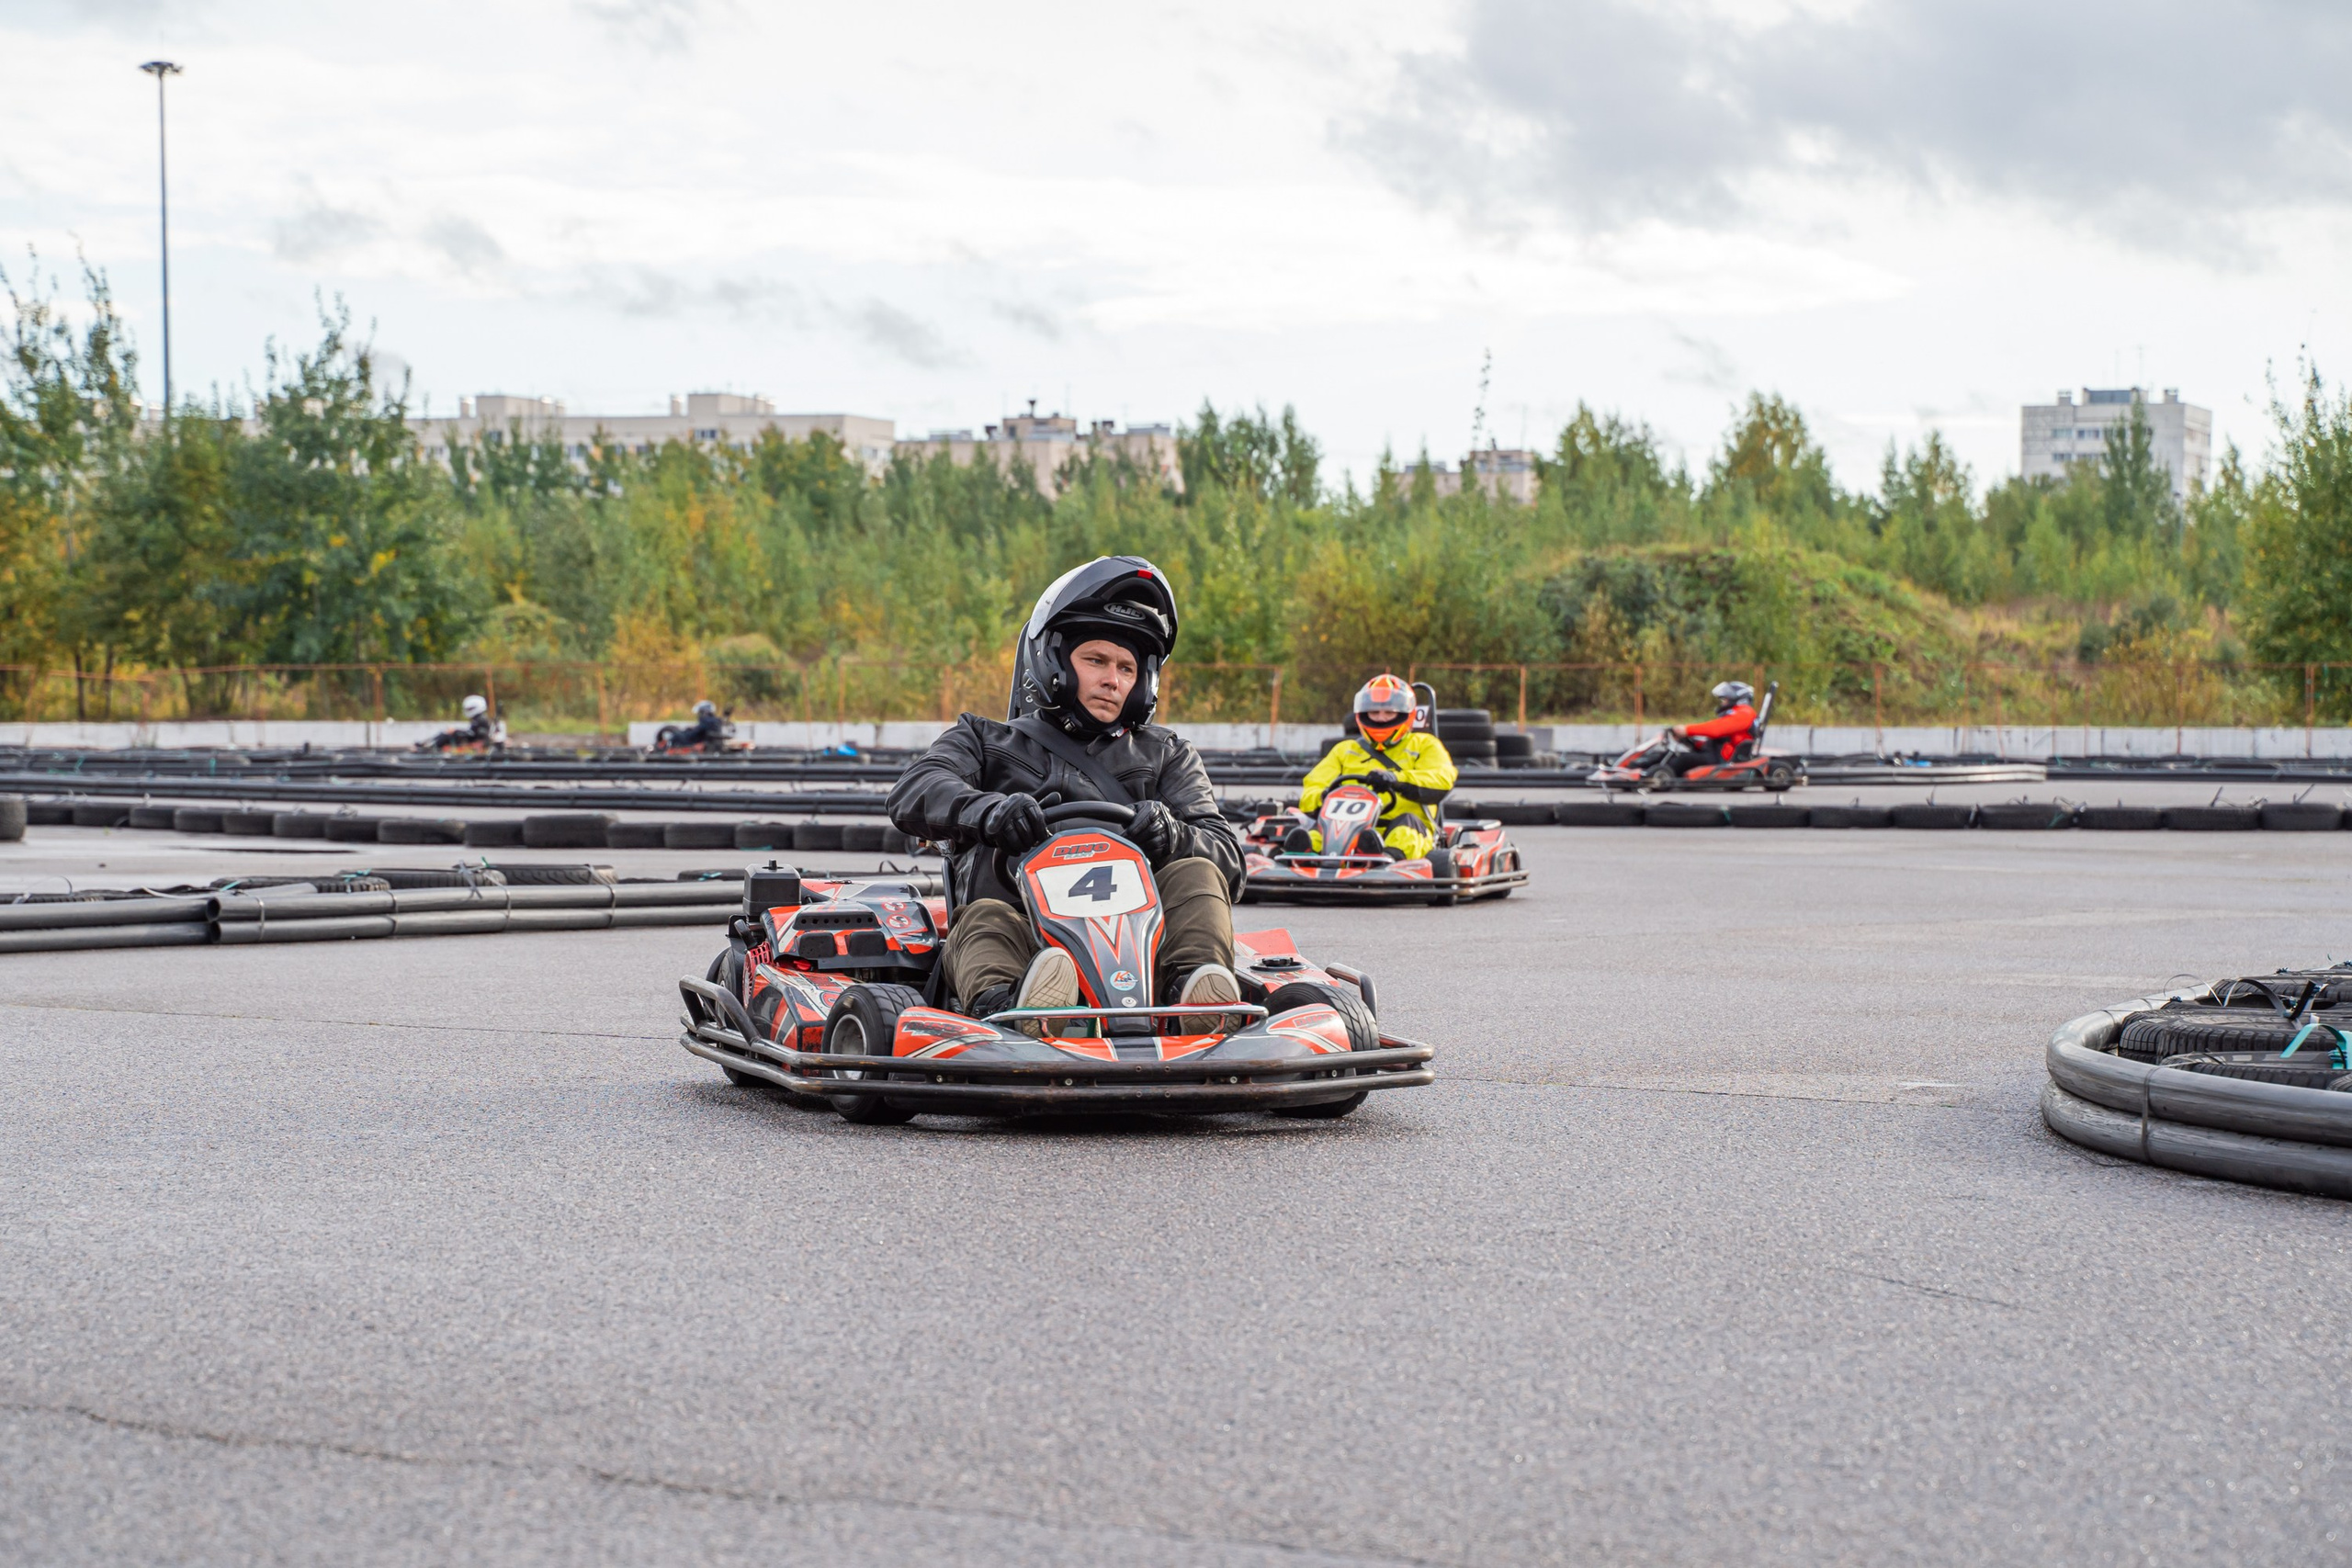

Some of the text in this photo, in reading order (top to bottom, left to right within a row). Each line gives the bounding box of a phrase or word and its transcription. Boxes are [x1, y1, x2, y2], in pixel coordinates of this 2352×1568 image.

[1110, 604, 1141, 616] HJC
[1331, 800, 1366, 815] 10
[1052, 842, 1110, 857] DINO
[1069, 865, 1117, 902] 4
